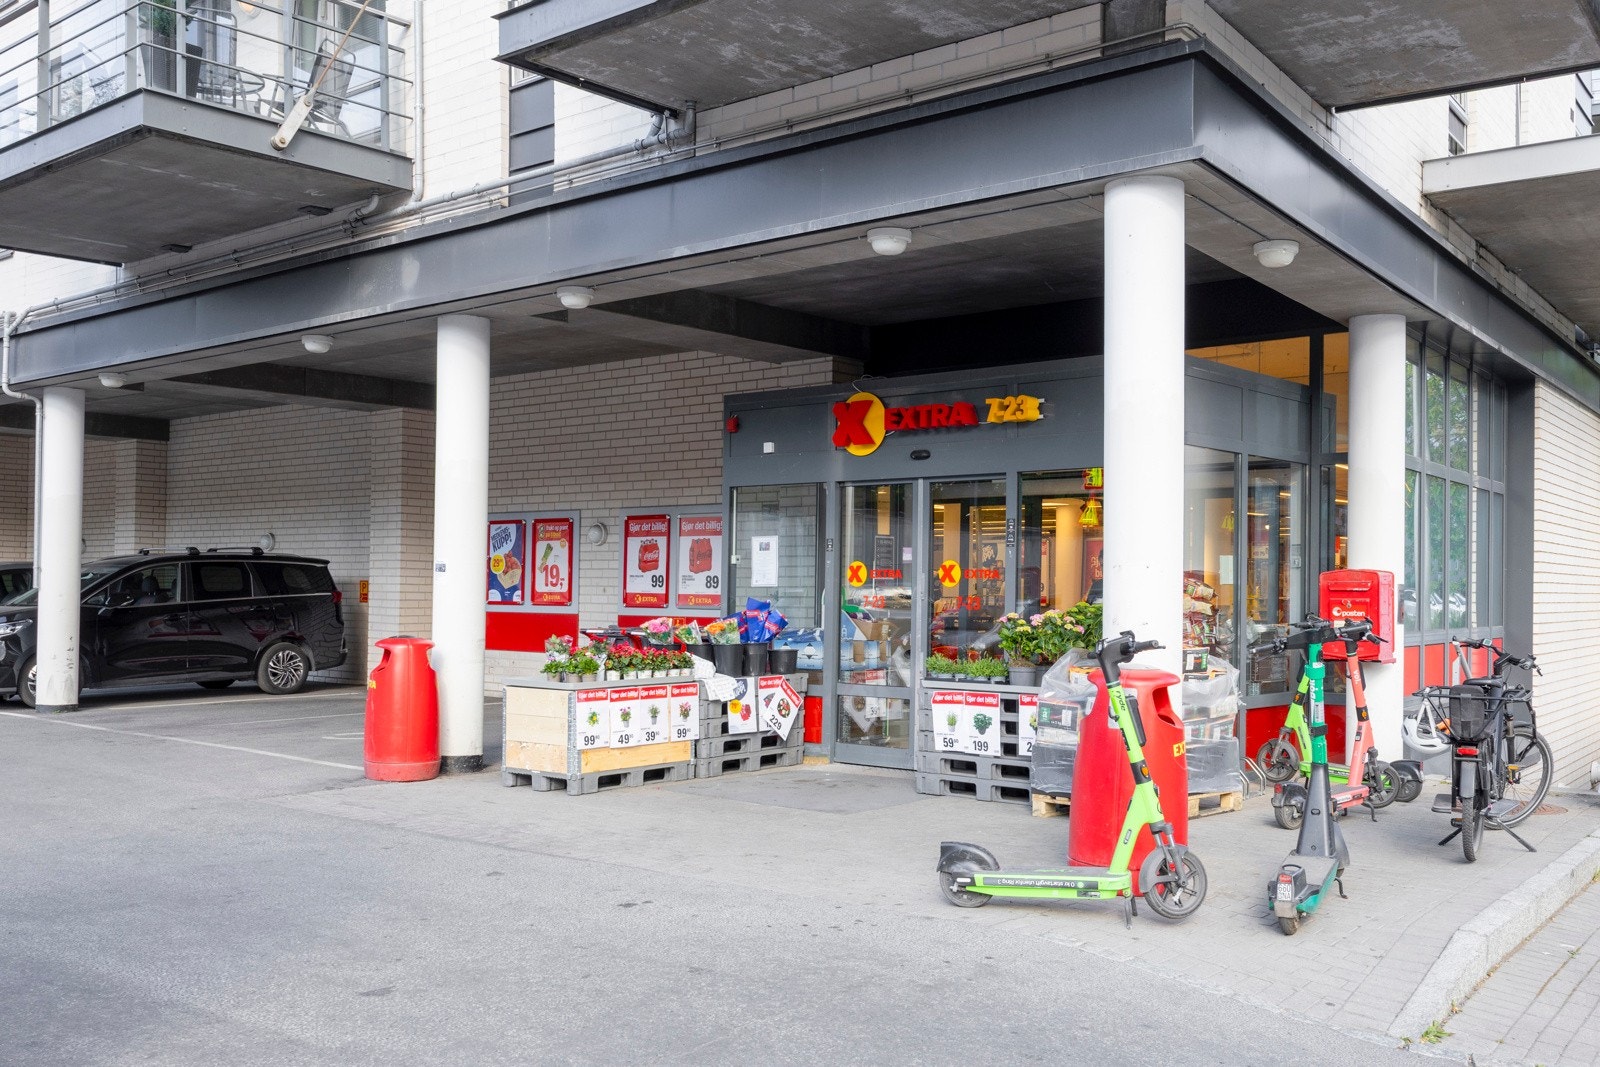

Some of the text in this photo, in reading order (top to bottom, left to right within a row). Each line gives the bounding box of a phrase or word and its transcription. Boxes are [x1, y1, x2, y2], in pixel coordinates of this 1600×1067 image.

[884, 401, 979, 430] EXTRA
[985, 395, 1041, 424] 7-23
[629, 522, 668, 533] Gjør det billig!
[681, 520, 722, 532] Gjør det billig!
[492, 532, 512, 552] KUPP!
[870, 570, 902, 579] EXTRA
[964, 569, 1001, 580] EXTRA
[651, 574, 664, 588] 99
[706, 575, 720, 589] 89
[1341, 610, 1366, 618] posten
[934, 694, 944, 702] Gjør
[966, 695, 976, 704] Gjør
[985, 696, 998, 705] billig!
[1116, 690, 1126, 712] ryde
[770, 714, 782, 730] 229
[646, 731, 656, 742] 39
[677, 728, 687, 738] 99
[584, 735, 596, 746] 99
[618, 734, 630, 744] 49
[943, 738, 954, 748] 59
[973, 740, 988, 752] 199
